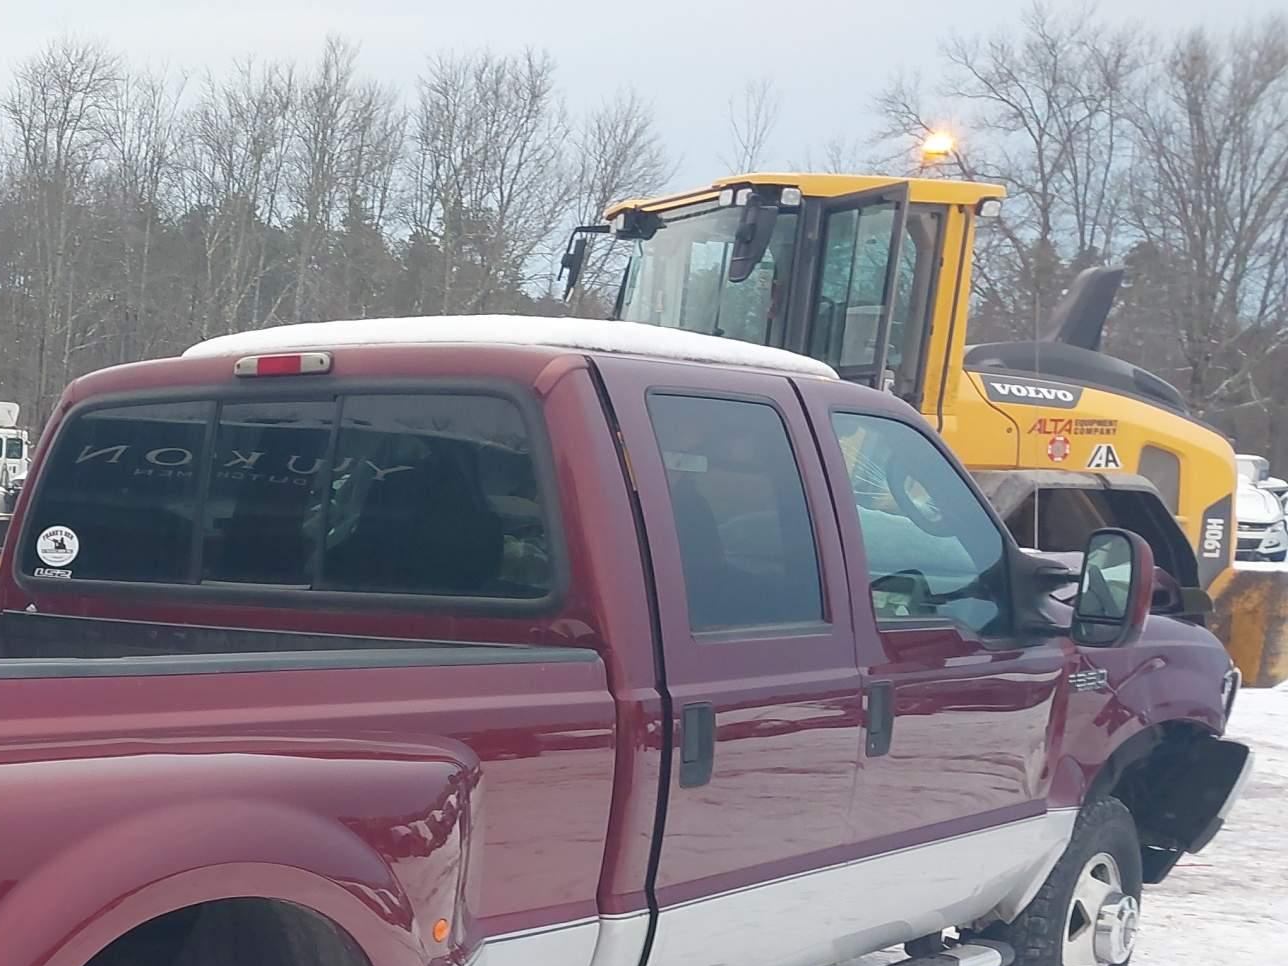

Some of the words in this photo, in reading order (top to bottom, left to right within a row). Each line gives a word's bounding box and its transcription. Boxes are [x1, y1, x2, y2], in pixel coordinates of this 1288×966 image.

[990, 382, 1074, 401] VOLVO
[1027, 418, 1073, 434] ALTA
[1202, 518, 1225, 558] L90H
